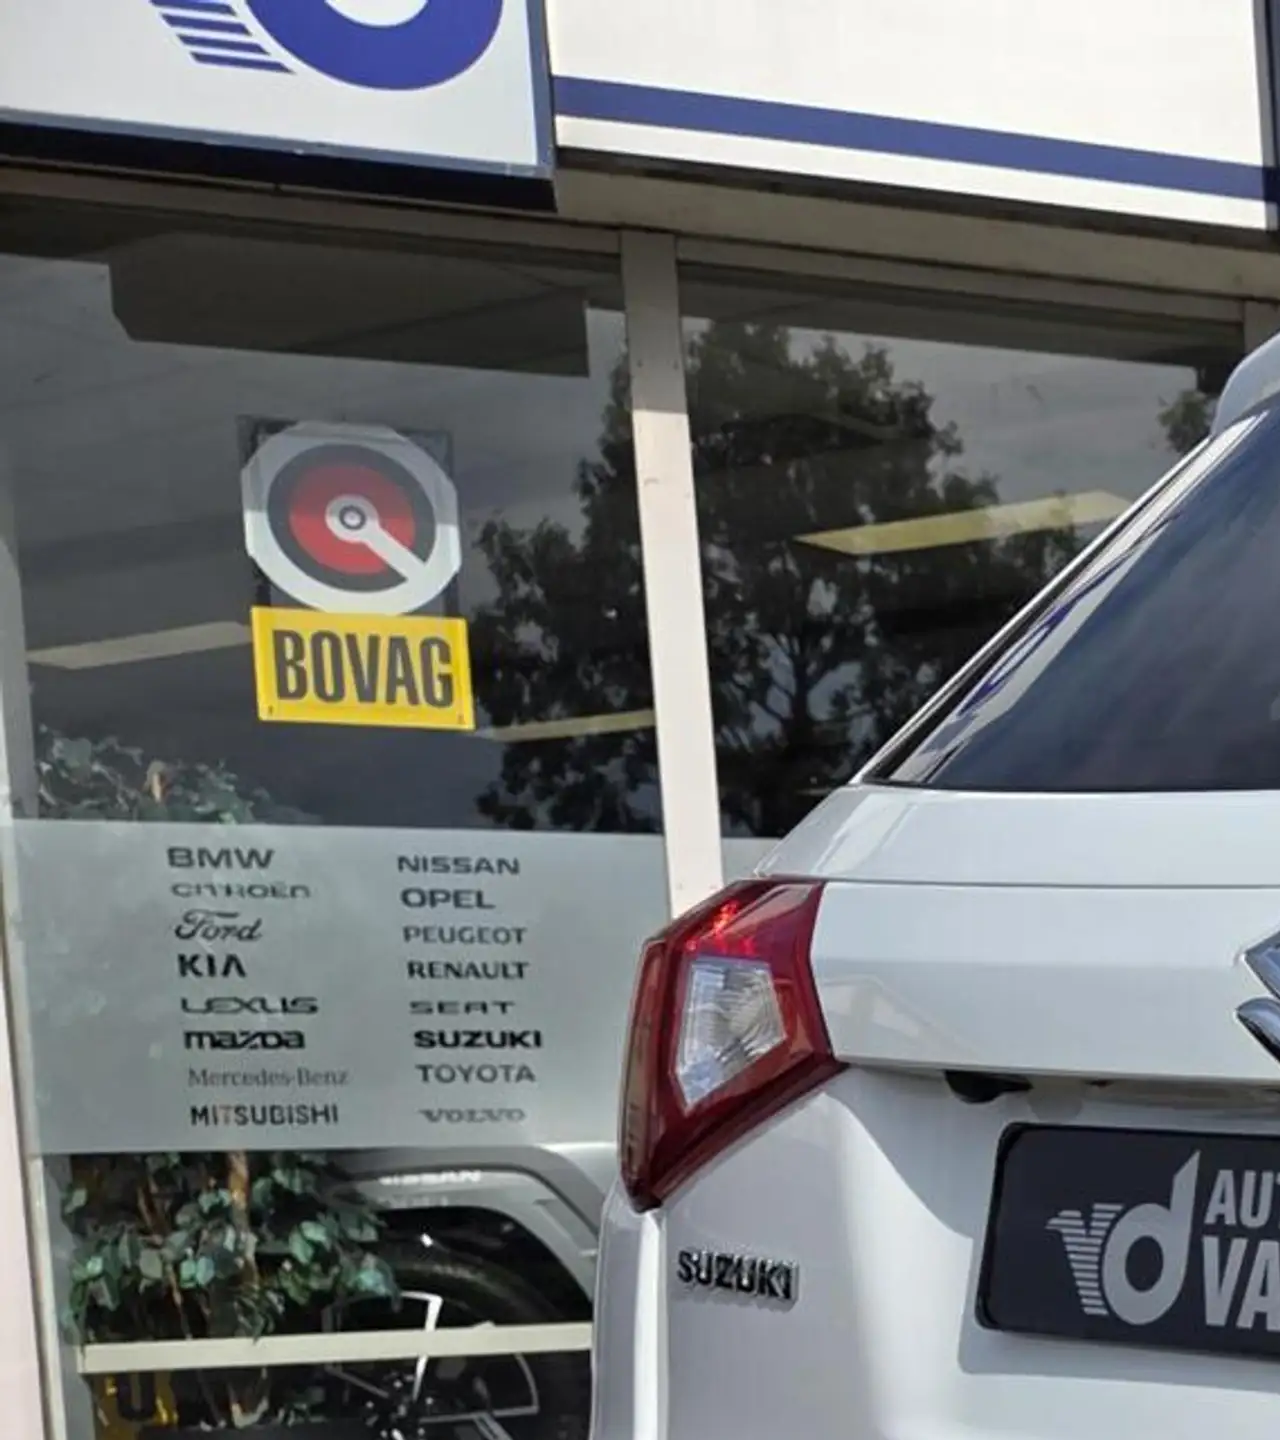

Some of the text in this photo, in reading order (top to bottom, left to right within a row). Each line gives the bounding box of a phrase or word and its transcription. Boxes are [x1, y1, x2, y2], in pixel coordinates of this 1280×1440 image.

[272, 628, 454, 709] BOVAG
[166, 846, 274, 869] BMW
[397, 855, 521, 876] NISSAN
[401, 887, 496, 910] OPEL
[174, 908, 263, 941] Ford
[403, 924, 528, 946] PEUGEOT
[177, 953, 247, 978] KIA
[407, 960, 530, 980] RENAULT
[181, 996, 319, 1015] LEXUS
[409, 1000, 516, 1015] SEAT
[413, 1029, 543, 1049] SUZUKI
[187, 1065, 349, 1087] Mercedes-Benz
[415, 1063, 536, 1084] TOYOTA
[189, 1104, 339, 1127] MITSUBISHI
[418, 1107, 527, 1124] VOLVO
[677, 1248, 799, 1302] SUZUKI
